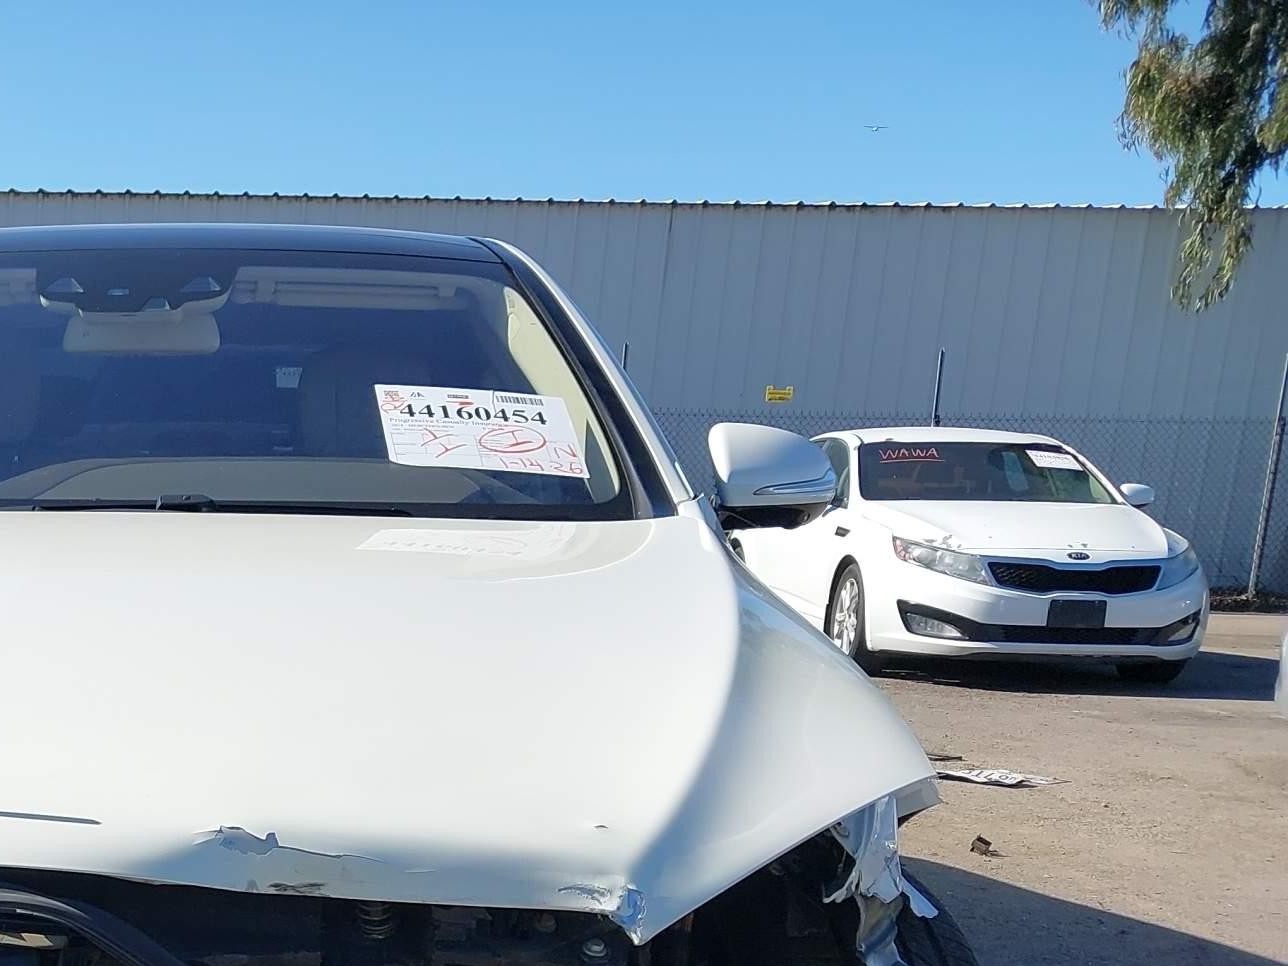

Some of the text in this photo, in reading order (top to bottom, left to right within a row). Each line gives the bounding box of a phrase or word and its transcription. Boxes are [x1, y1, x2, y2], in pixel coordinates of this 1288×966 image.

[400, 402, 548, 426] 44160454
[878, 447, 940, 460] WAWA
[1071, 552, 1088, 560] KIA
